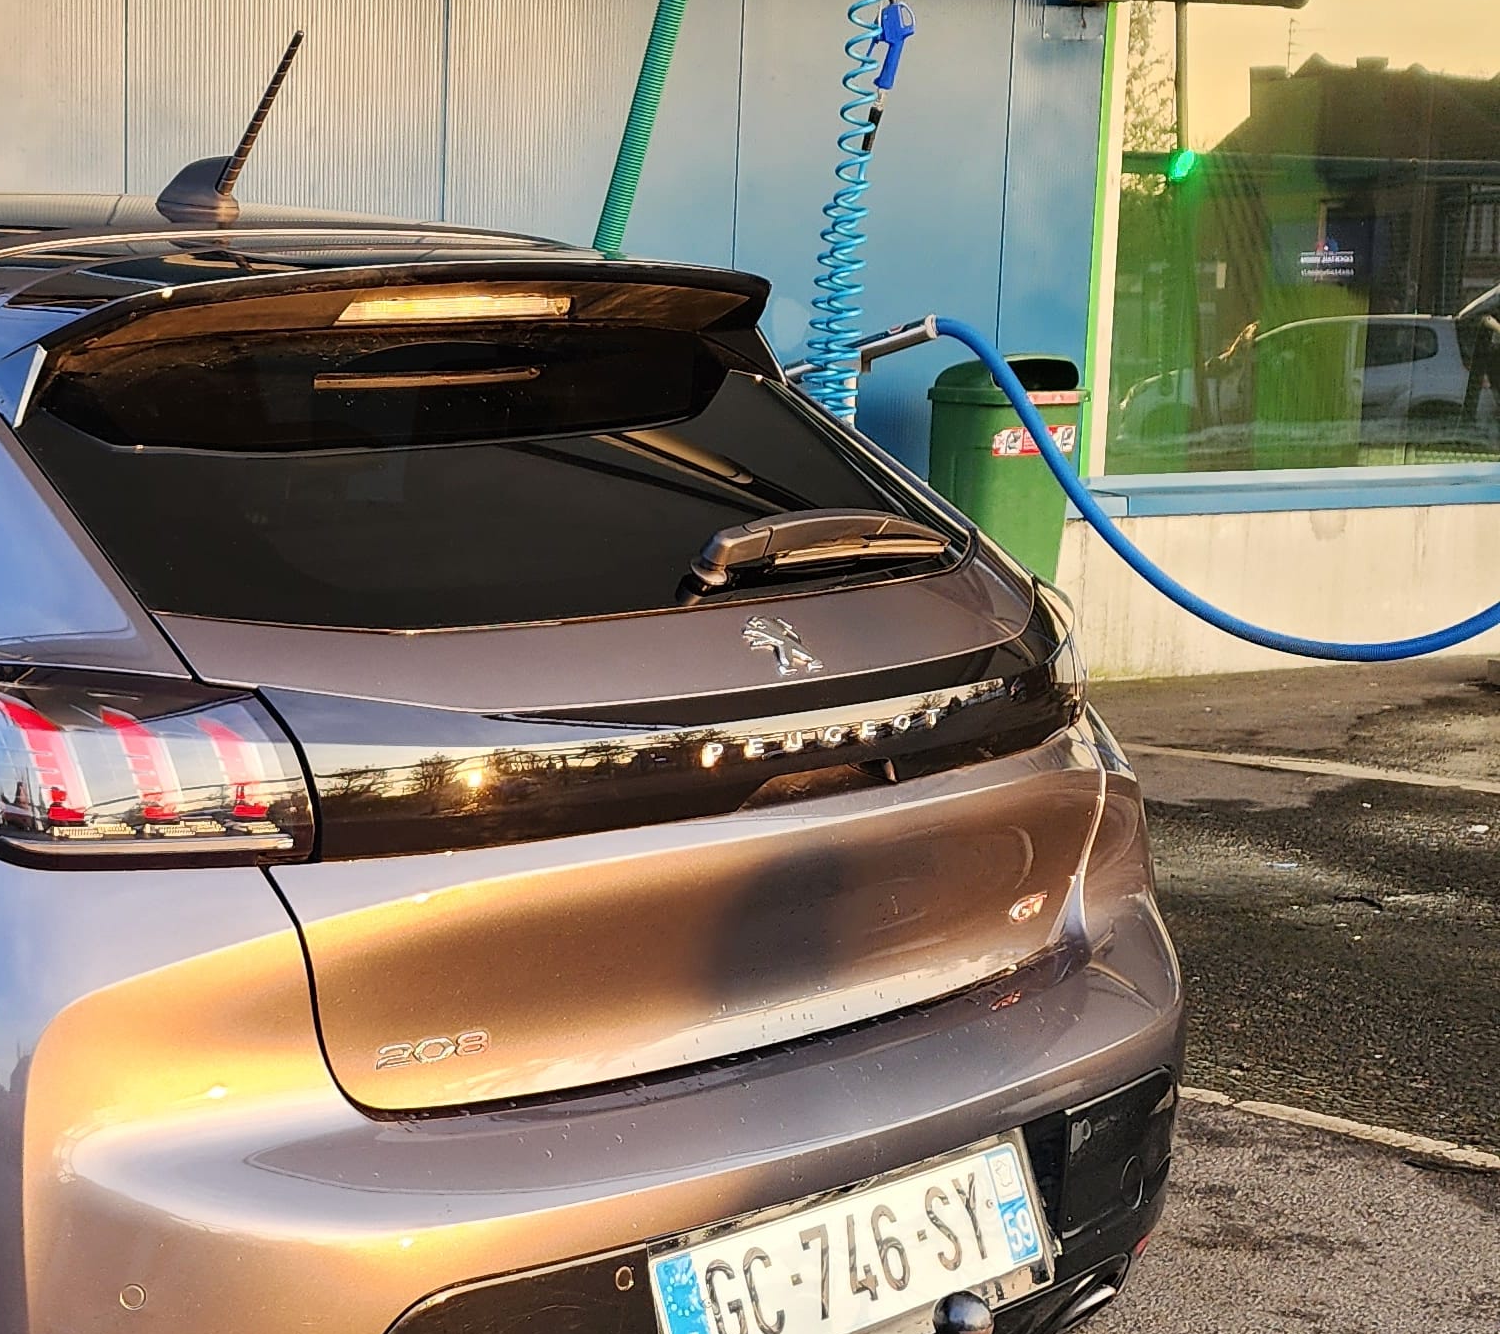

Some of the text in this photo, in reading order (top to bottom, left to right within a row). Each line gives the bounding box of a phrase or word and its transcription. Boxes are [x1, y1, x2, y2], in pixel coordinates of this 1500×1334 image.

[701, 708, 941, 768] PEUGEOT
[375, 1029, 490, 1071] 208
[1003, 1207, 1035, 1252] 59
